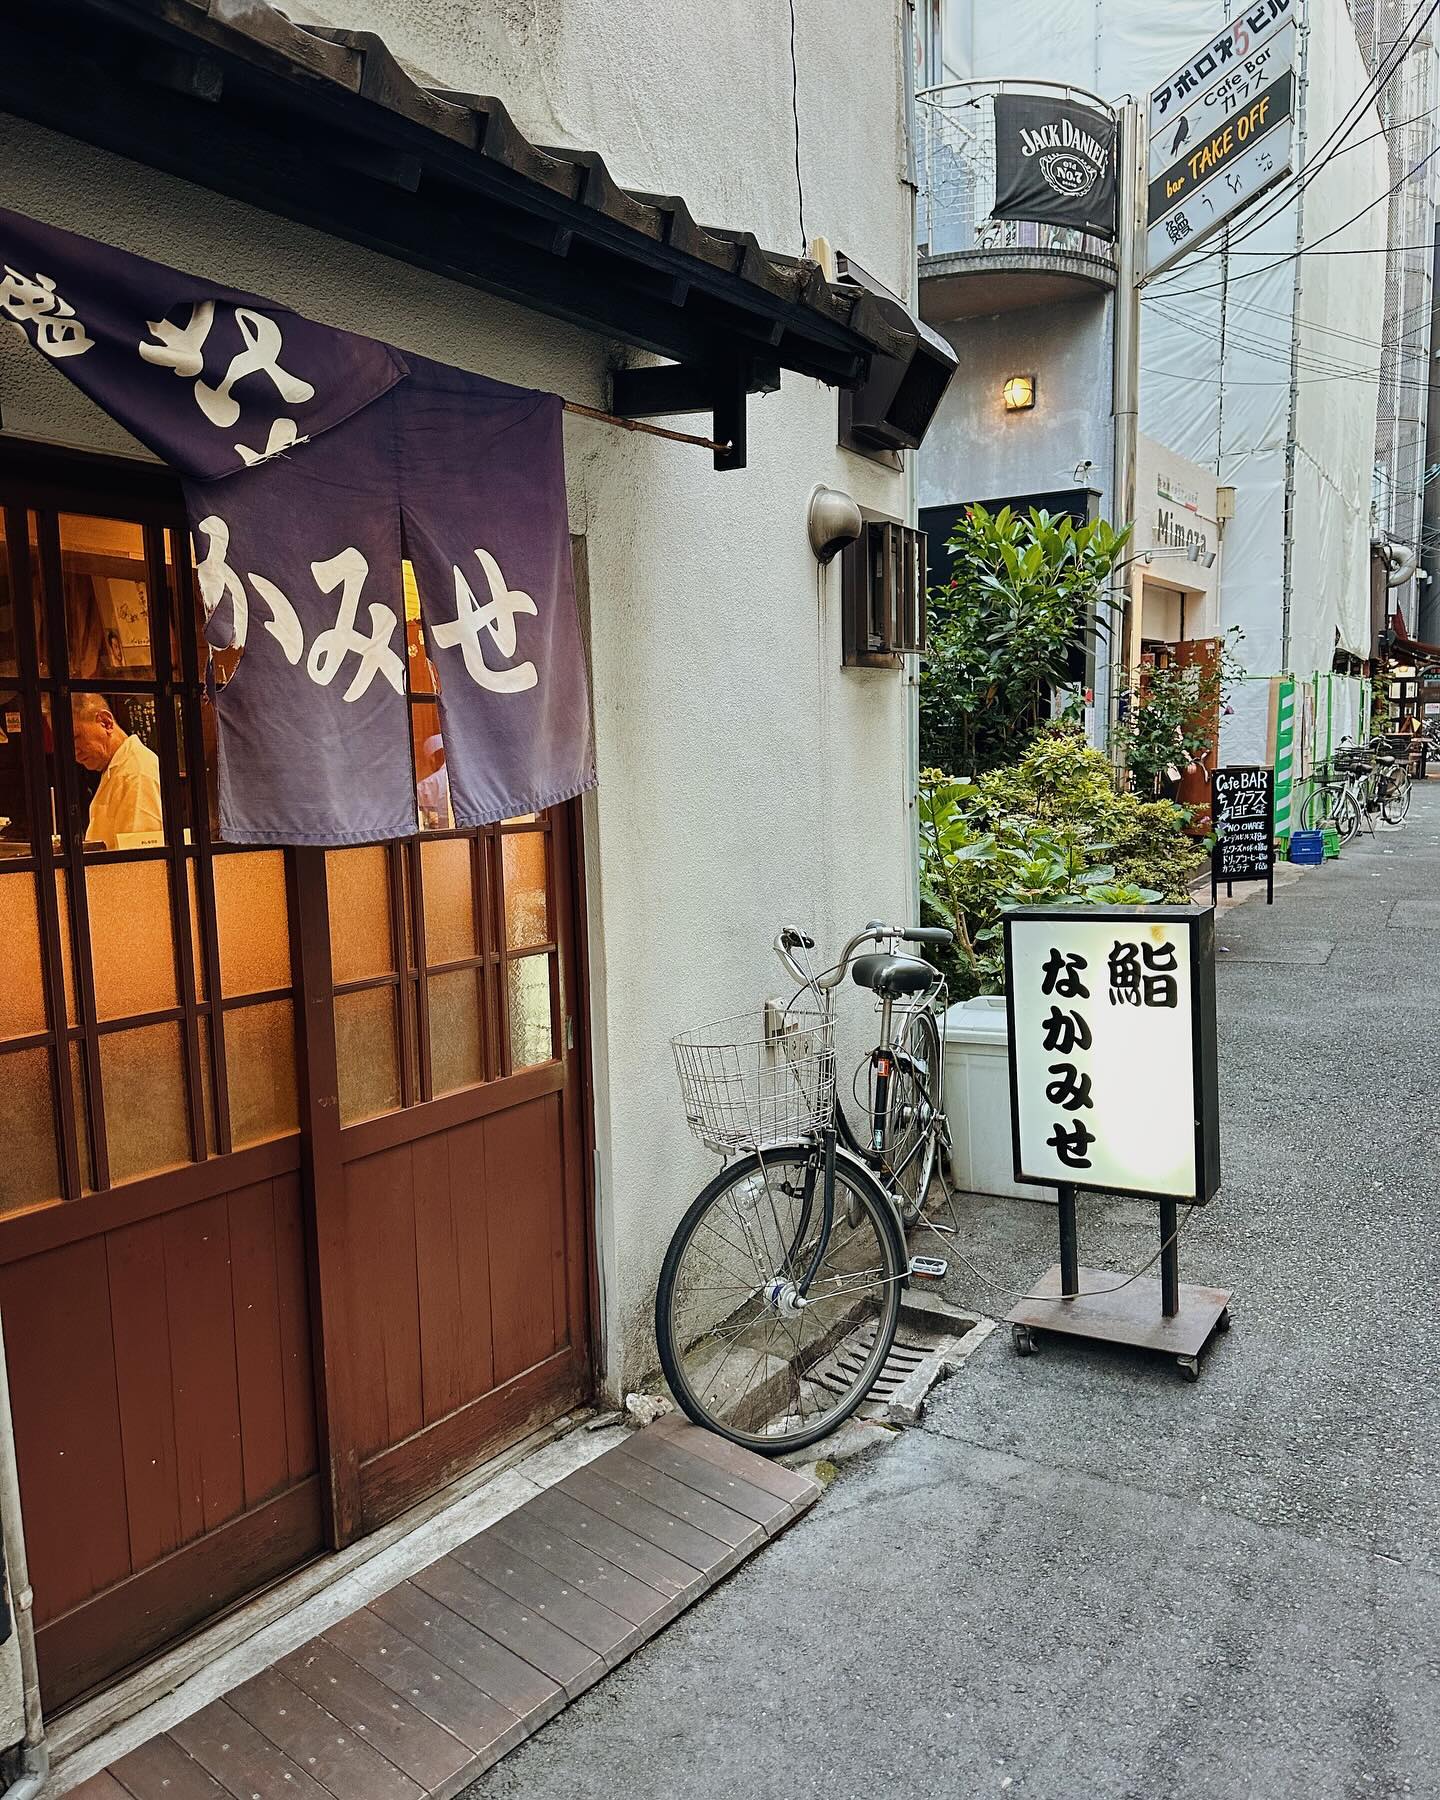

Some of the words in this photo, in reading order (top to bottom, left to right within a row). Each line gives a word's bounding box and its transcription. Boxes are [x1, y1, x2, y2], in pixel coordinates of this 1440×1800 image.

[1204, 74, 1242, 107] Cafe
[1244, 48, 1271, 74] Bar
[1221, 68, 1269, 114] カラス
[1019, 125, 1062, 157] JACK
[1166, 177, 1185, 198] bar
[1188, 127, 1233, 180] TAKE
[1237, 96, 1270, 142] OFF
[1216, 774, 1240, 792] Cafe
[1240, 771, 1268, 789] BAR
[1233, 790, 1268, 806] カラス
[1108, 940, 1178, 1008] 鮨
[1041, 947, 1096, 1169] なかみせ
